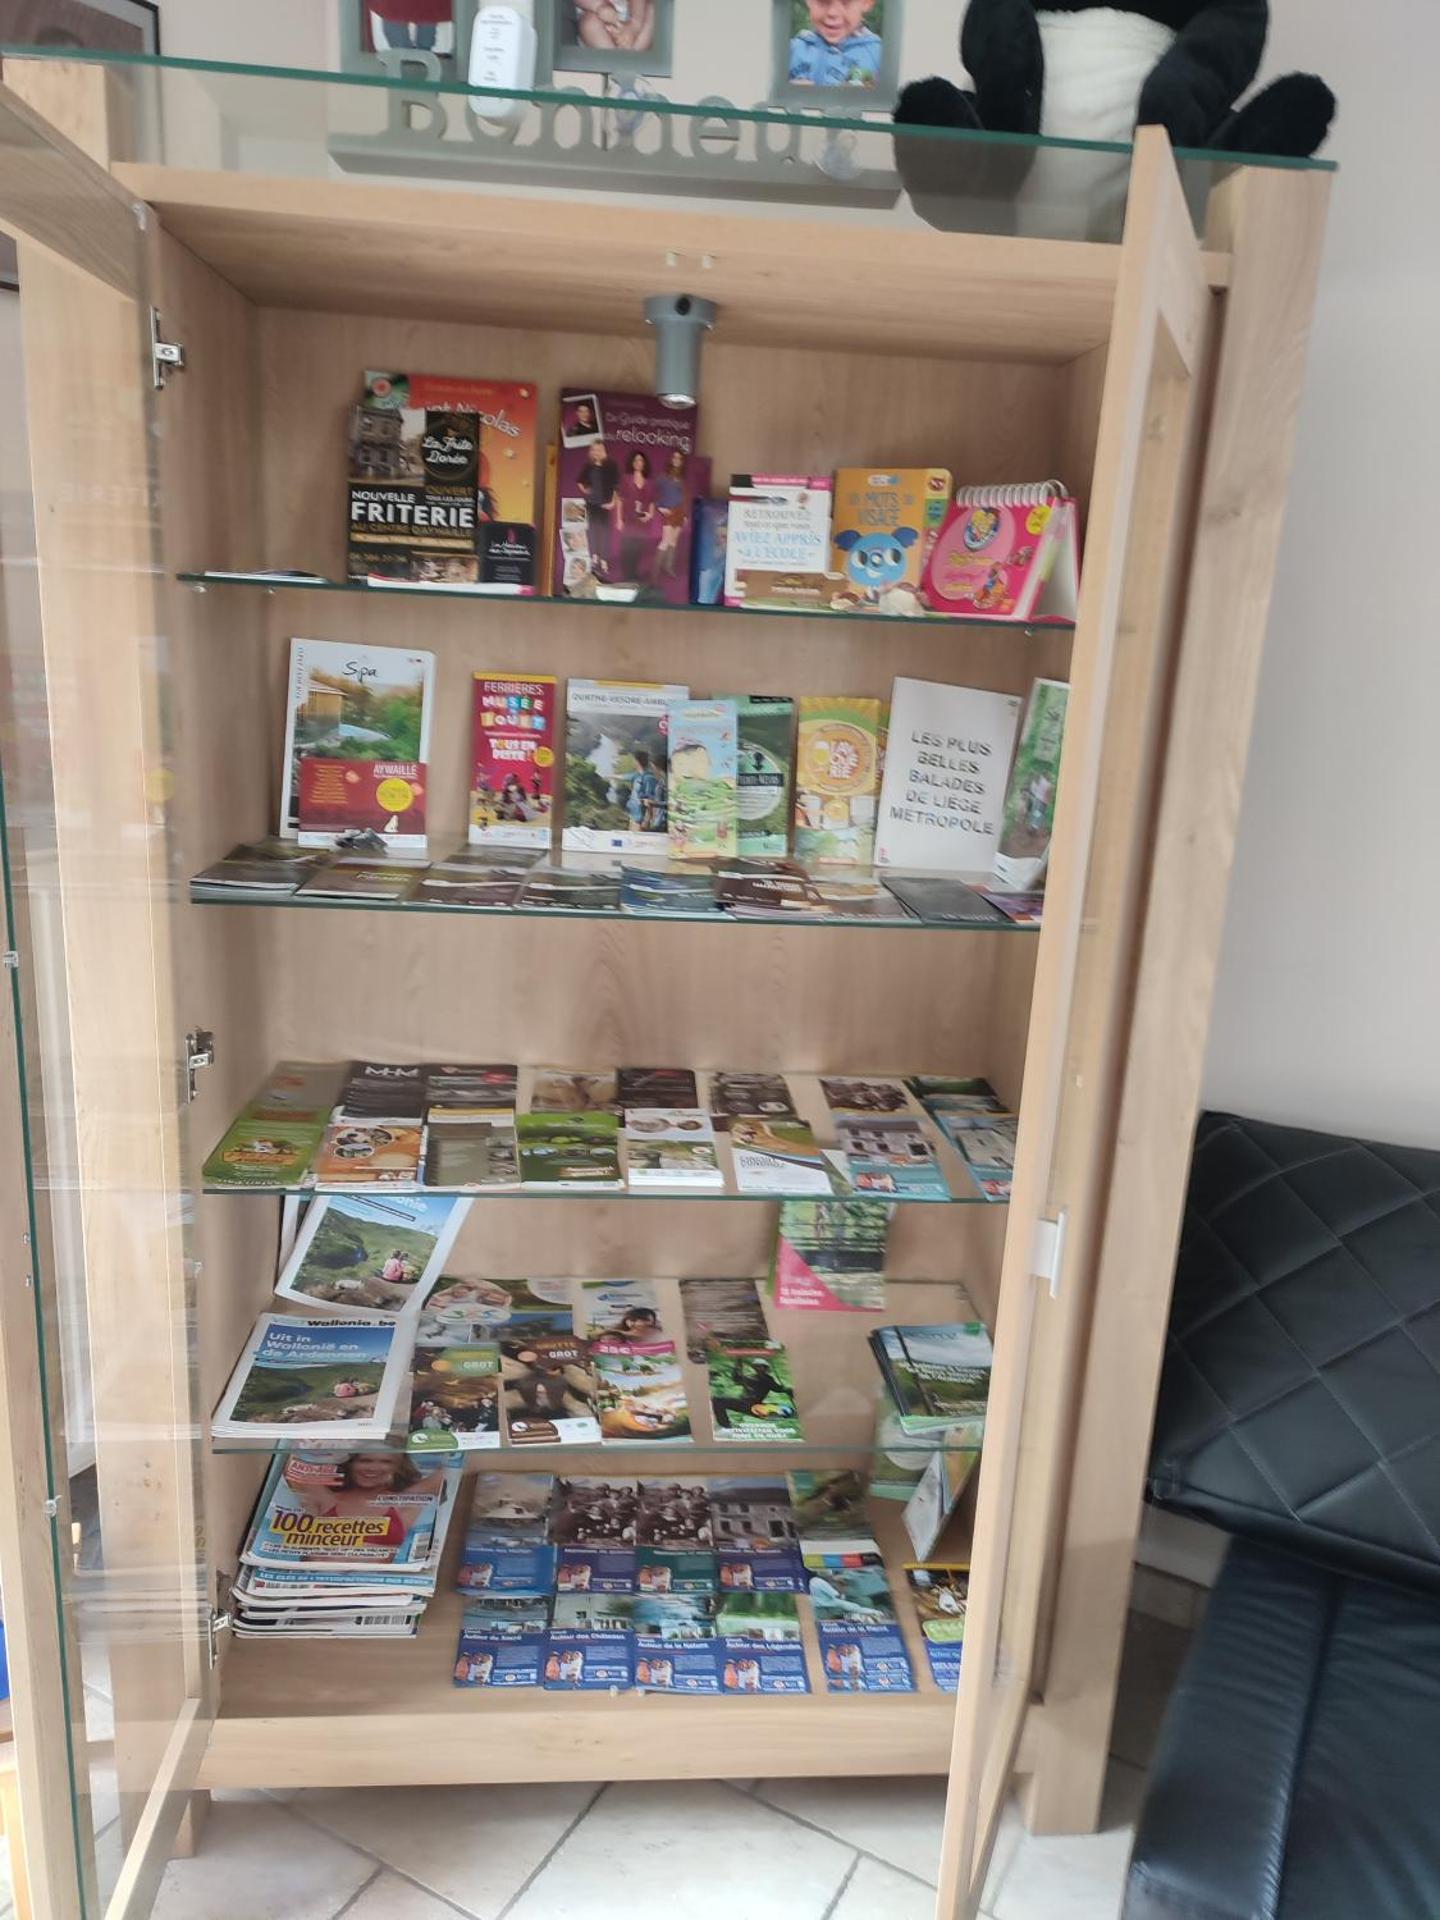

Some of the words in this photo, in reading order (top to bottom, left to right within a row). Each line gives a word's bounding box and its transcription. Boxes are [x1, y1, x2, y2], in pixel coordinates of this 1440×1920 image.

[616, 425, 690, 454] relooking
[351, 490, 416, 504] NOUVELLE
[351, 501, 475, 528] FRITERIE
[343, 661, 379, 682] Spa
[911, 730, 943, 748] LES
[947, 736, 993, 757] PLUS
[917, 750, 981, 775] BELLES
[909, 769, 986, 795] BALADES
[905, 789, 929, 805] DE
[269, 1332, 293, 1342] Uit
[296, 1334, 312, 1342] in
[262, 1348, 284, 1357] de
[266, 1340, 337, 1350] Wallonië
[339, 1343, 359, 1351] en
[548, 1350, 580, 1359] GROT
[463, 1360, 494, 1370] GROT
[272, 1509, 314, 1533] 100
[314, 1519, 385, 1535] recettes
[286, 1532, 361, 1547] minceur
